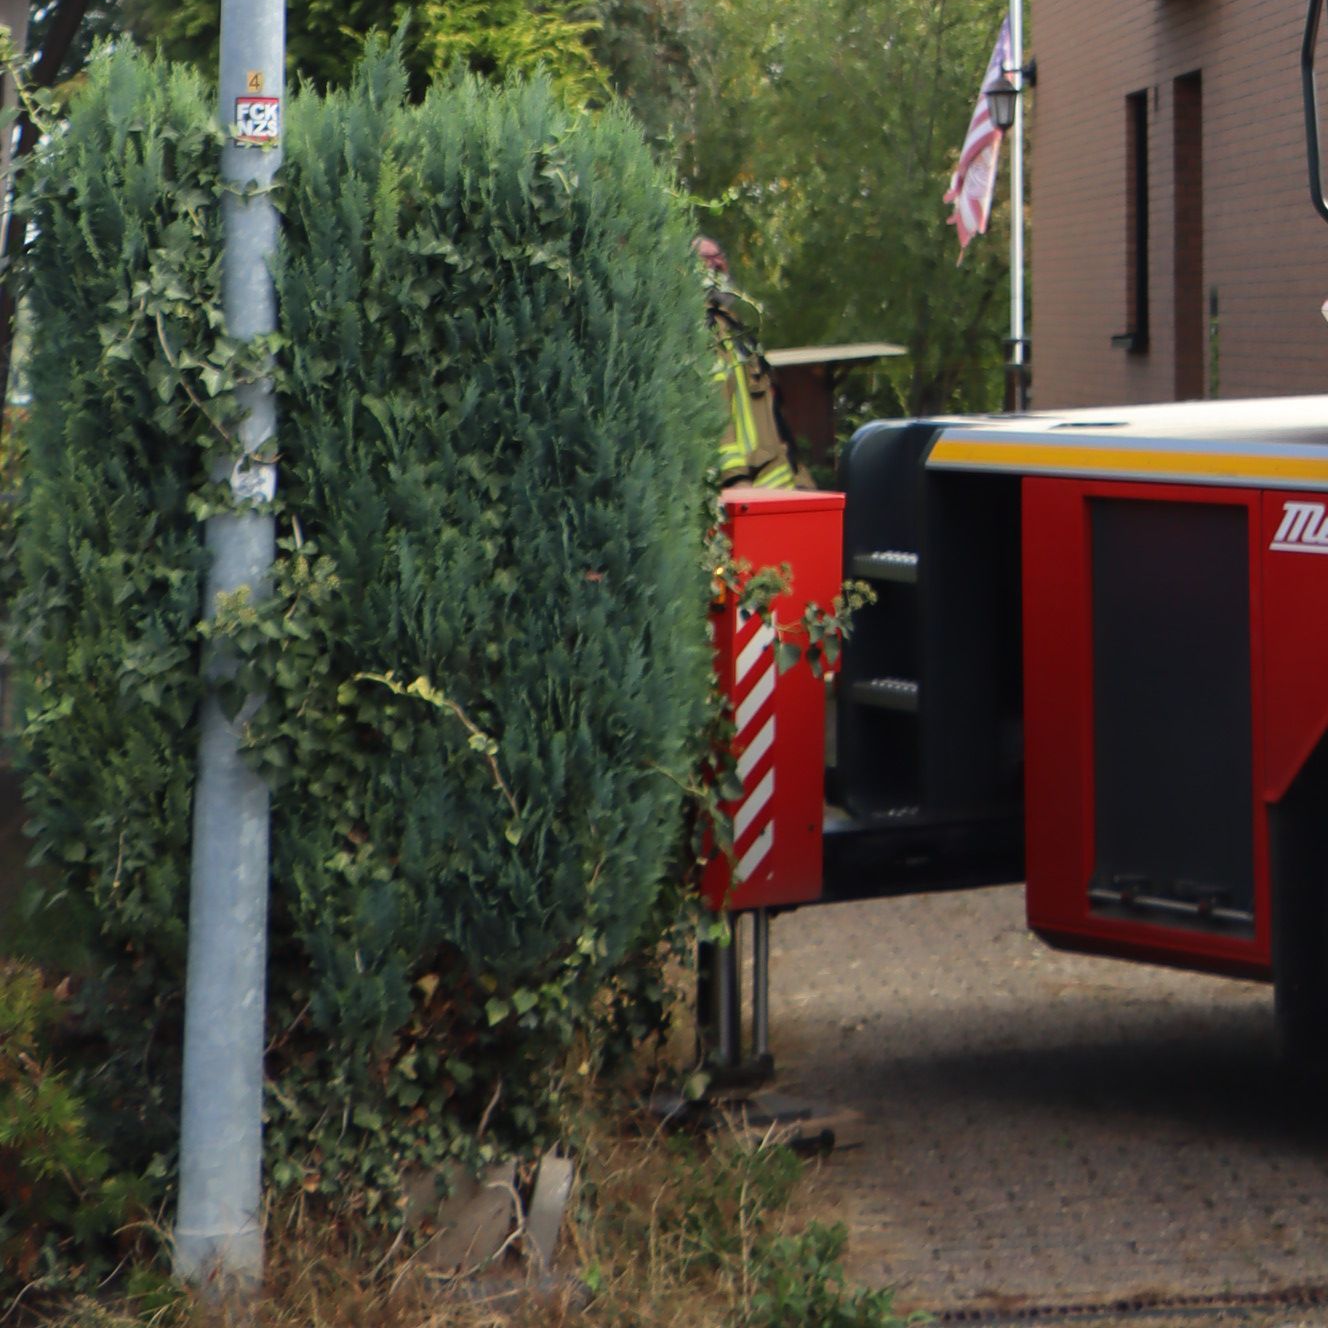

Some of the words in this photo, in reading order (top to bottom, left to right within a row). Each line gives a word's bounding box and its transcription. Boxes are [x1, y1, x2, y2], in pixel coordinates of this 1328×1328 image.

[248, 72, 262, 91] 4
[236, 103, 278, 120] FCK
[236, 120, 278, 137] NZS
